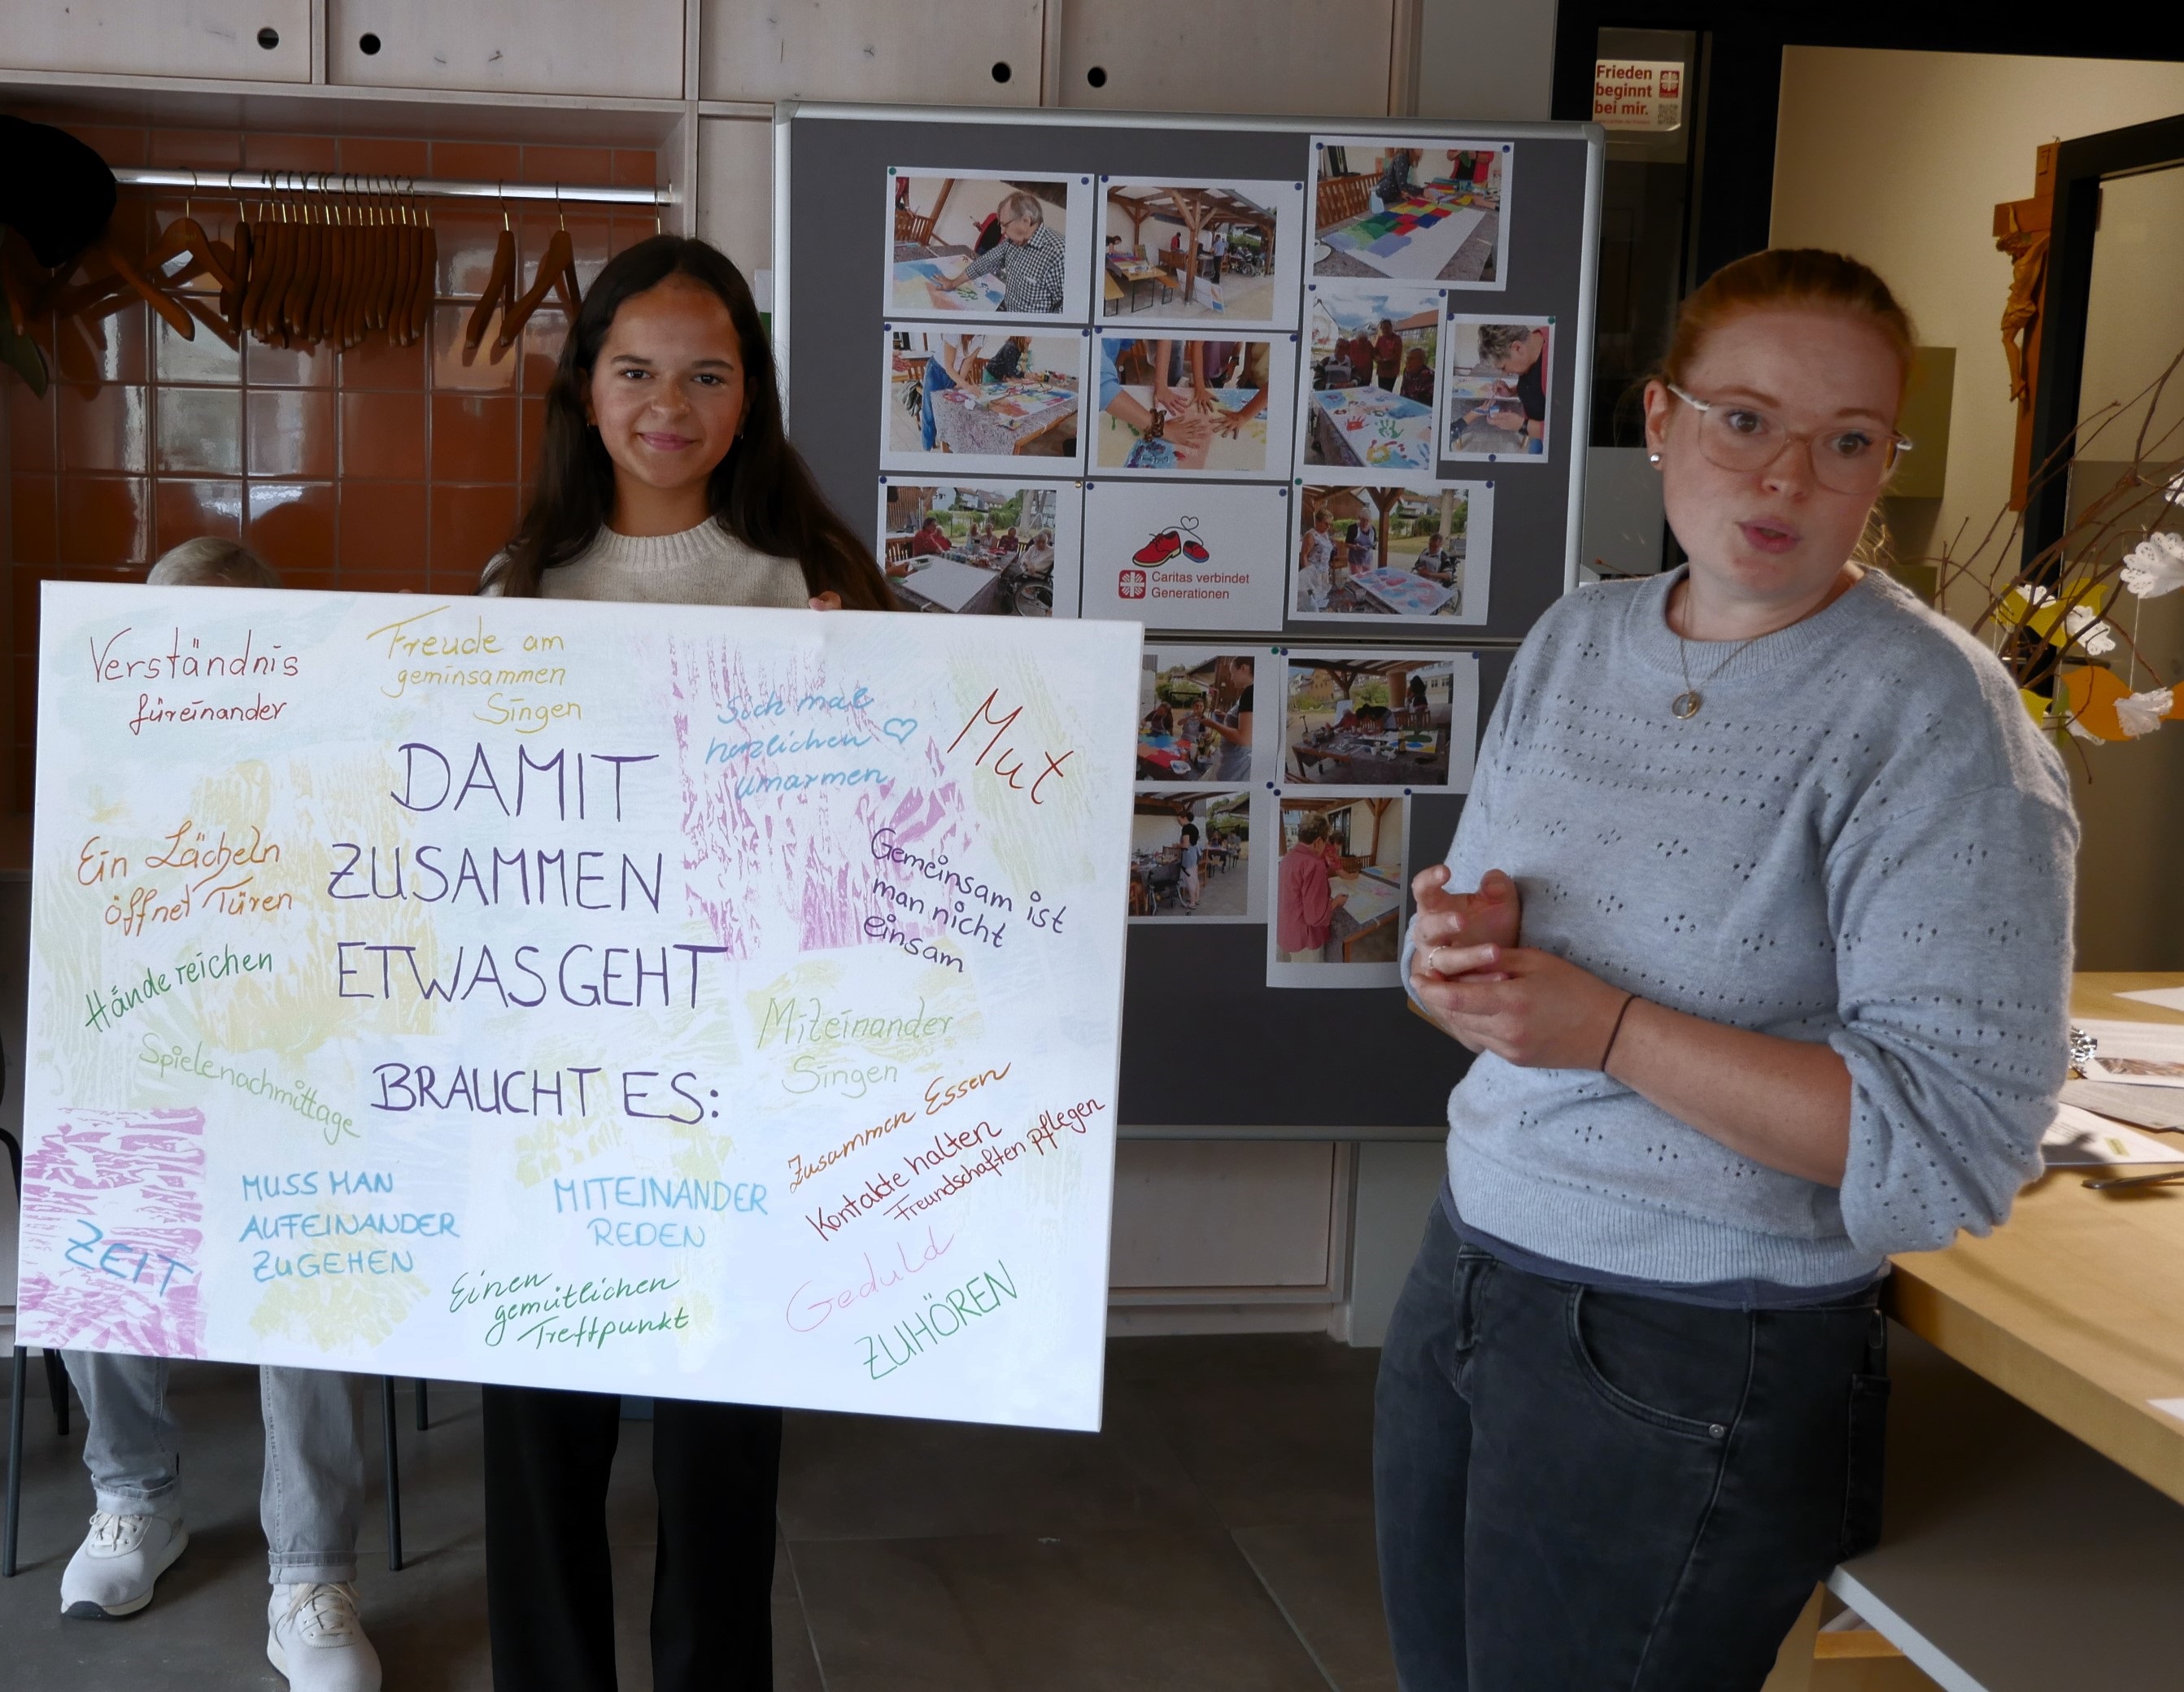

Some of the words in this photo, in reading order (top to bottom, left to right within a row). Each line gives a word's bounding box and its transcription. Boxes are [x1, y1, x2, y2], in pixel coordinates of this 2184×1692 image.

[1596, 65, 1652, 80] Frieden
[1596, 82, 1652, 100] beginnt
[1594, 101, 1617, 114] bei
[1621, 101, 1649, 115] mir.
[1152, 571, 1192, 582] Caritas
[1197, 573, 1250, 584] verbindet
[1152, 587, 1229, 600] Generationen
[90, 627, 299, 683] Verständnis
[367, 606, 503, 660] Freude
[523, 634, 565, 652] am
[381, 665, 566, 698] geminsammen
[797, 687, 874, 712] mal
[129, 694, 288, 735] füreinander
[473, 692, 582, 734] Singen
[948, 688, 1075, 805] Mut
[390, 742, 660, 822] DAMIT
[735, 768, 888, 800] umarmen
[78, 836, 127, 885] Ein
[145, 820, 280, 892] Lächeln
[327, 843, 663, 914] ZUSAMMEN
[870, 827, 1014, 913] Gemeinsam
[1027, 891, 1066, 934] ist
[105, 884, 190, 936] öffnet
[203, 876, 292, 915] Türen
[873, 877, 926, 918] man
[932, 901, 1006, 948] nicht
[863, 913, 965, 974] einsam
[85, 972, 172, 1034] Hände
[174, 944, 273, 989] reichen
[338, 941, 547, 1008] ETWAS
[559, 943, 729, 1009] GEHT
[757, 996, 953, 1049] Miteinander
[138, 1031, 361, 1146] Spielenachmittage
[371, 1062, 602, 1118] BRAUCHT
[622, 1071, 720, 1125] ES:
[782, 1055, 898, 1099] Singen
[787, 1111, 916, 1193] Zusammen
[924, 1062, 1012, 1115] Essen
[242, 1171, 319, 1201] MUSS
[328, 1171, 395, 1195] MAN
[805, 1171, 910, 1241] Kontakte
[904, 1120, 1003, 1176] halten
[883, 1140, 1027, 1221] Freundschaften
[1027, 1097, 1106, 1155] pflegen
[554, 1176, 769, 1216] MITEINANDER
[238, 1211, 460, 1243] AUFEINANDER
[588, 1218, 706, 1249] REDEN
[64, 1219, 194, 1297] ZEIT
[252, 1249, 415, 1283] ZUGEHEN
[786, 1225, 956, 1332] Geduld
[450, 1269, 553, 1313] Einen
[854, 1260, 1019, 1380] ZUHÖREN
